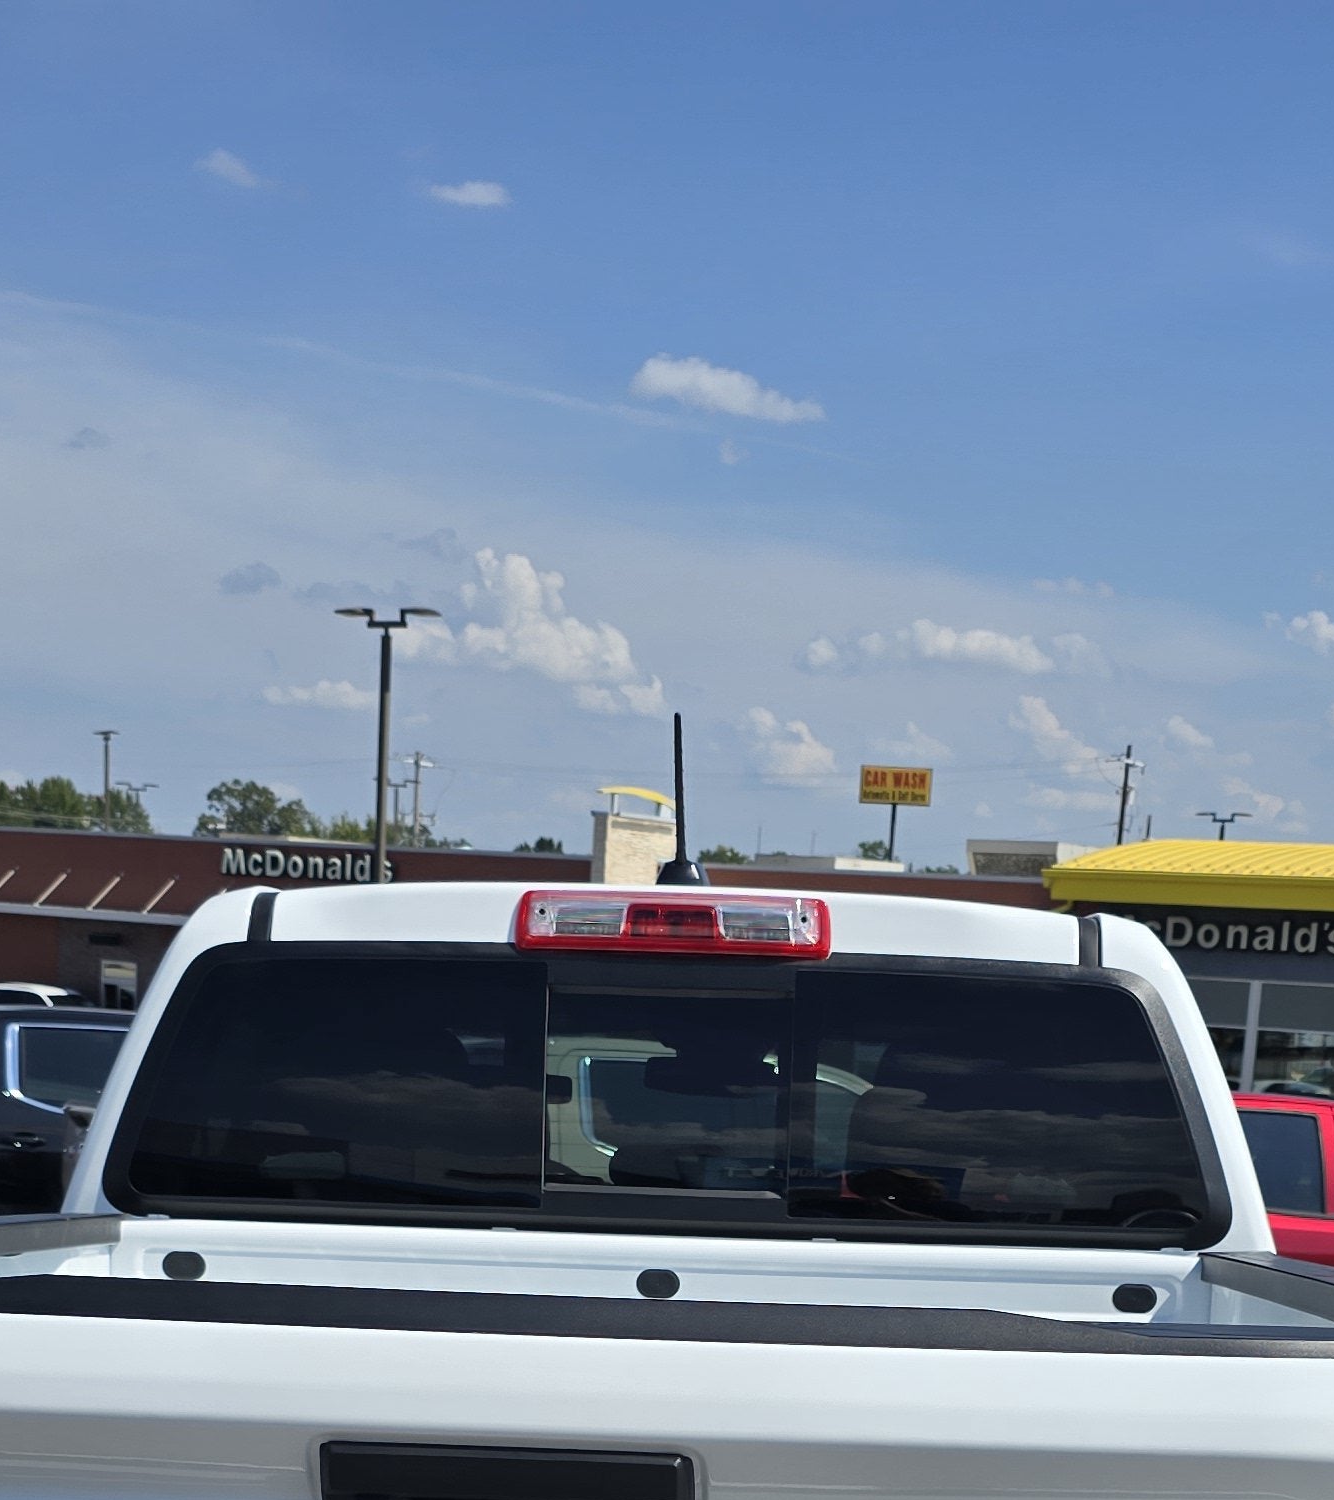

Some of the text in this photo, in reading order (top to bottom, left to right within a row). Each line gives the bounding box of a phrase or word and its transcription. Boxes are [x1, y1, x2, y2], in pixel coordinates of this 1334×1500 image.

[863, 770, 928, 790] CAR WASH
[221, 847, 394, 883] McDonalds
